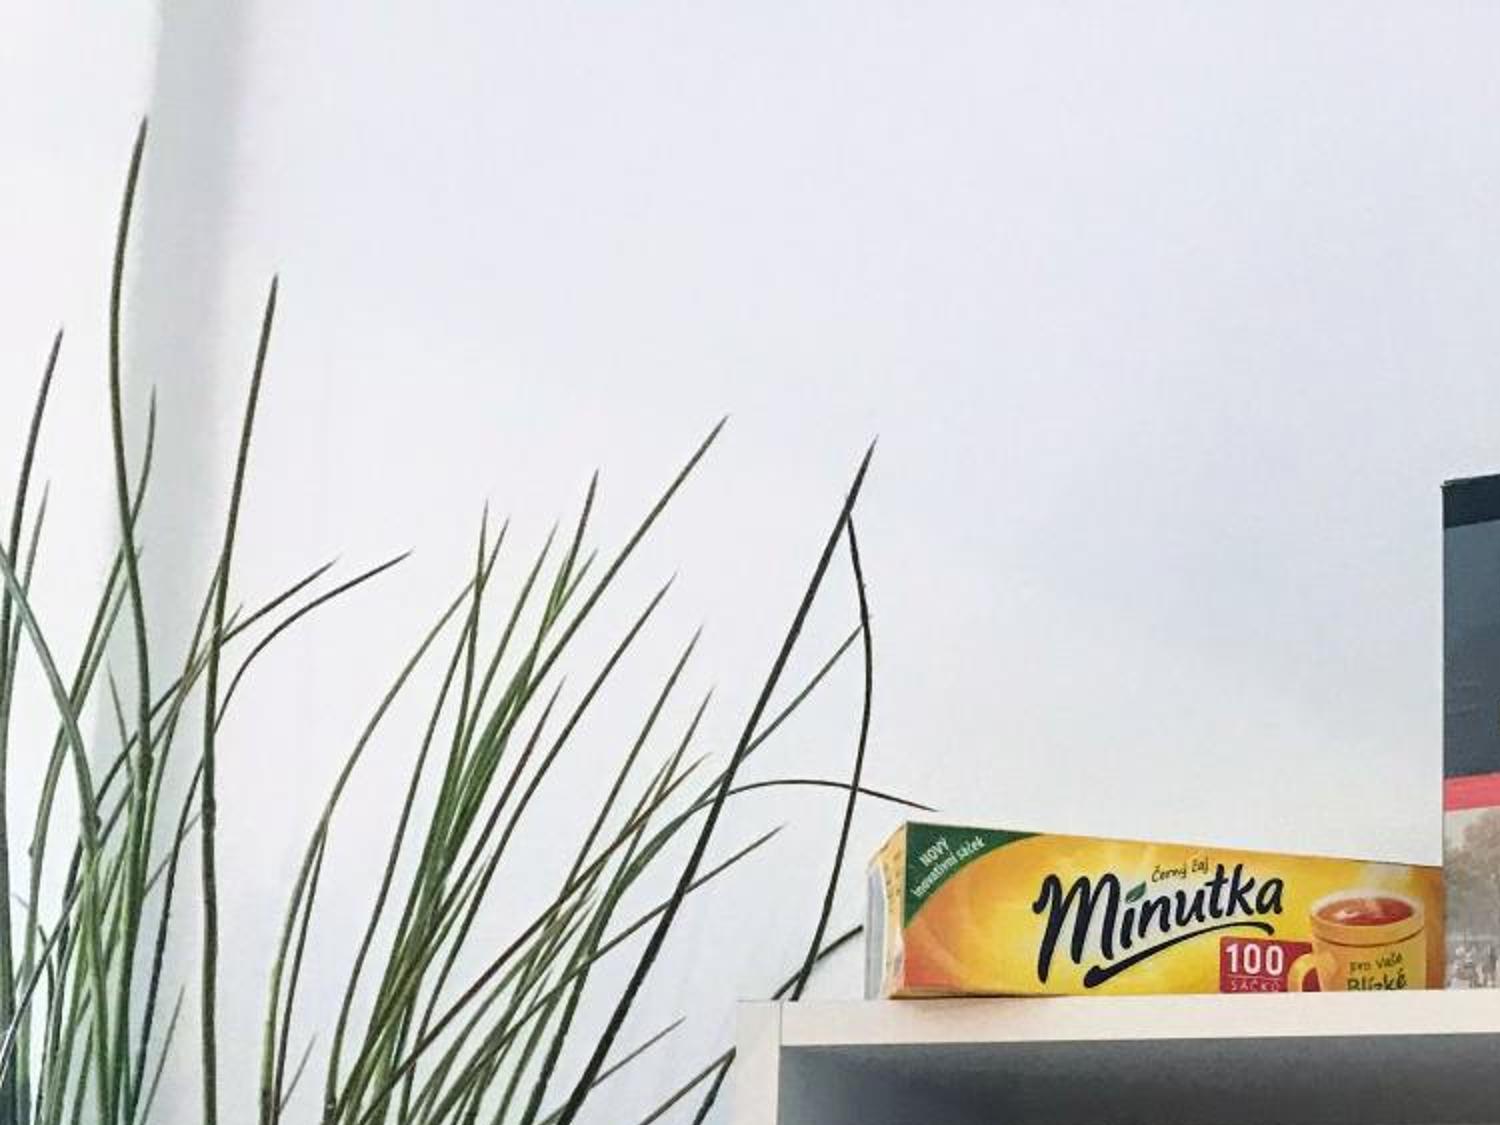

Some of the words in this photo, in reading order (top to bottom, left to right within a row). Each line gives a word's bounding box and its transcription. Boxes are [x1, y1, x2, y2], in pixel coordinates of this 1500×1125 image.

[1151, 864, 1187, 883] Černý
[1032, 863, 1285, 987] Minutka
[1225, 943, 1285, 977] 100
